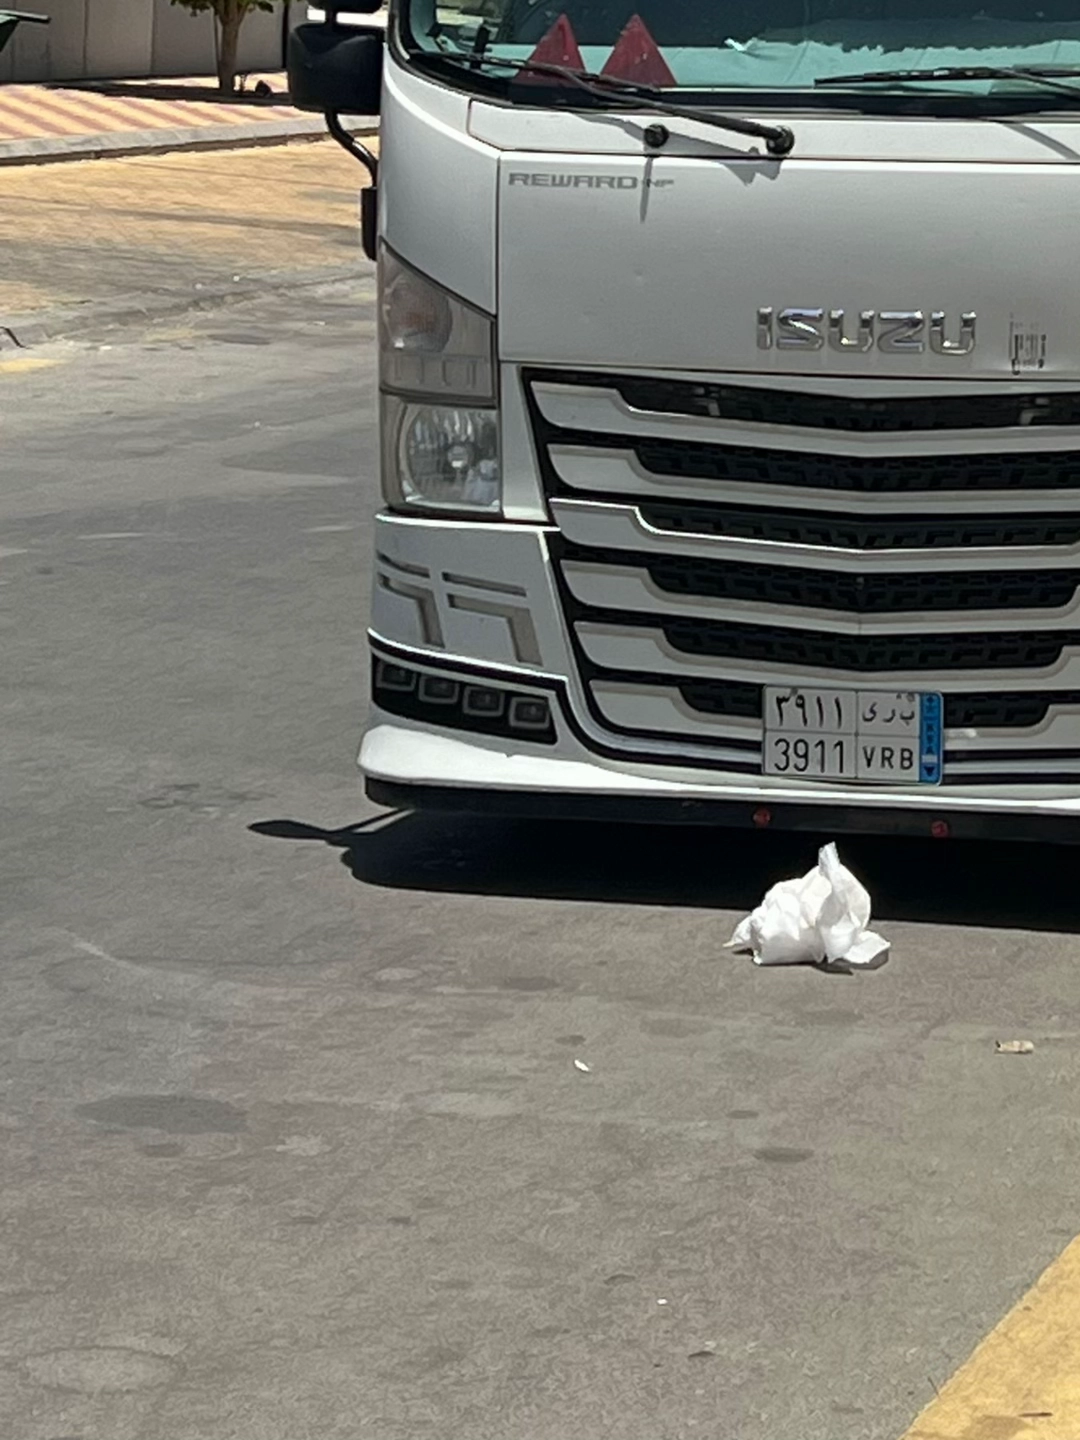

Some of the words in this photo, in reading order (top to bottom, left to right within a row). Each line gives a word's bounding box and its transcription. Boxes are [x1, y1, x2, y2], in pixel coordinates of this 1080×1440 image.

[508, 172, 638, 190] REWARD
[756, 307, 977, 356] ISUZU
[774, 738, 845, 774] 3911
[862, 745, 915, 771] VRB
